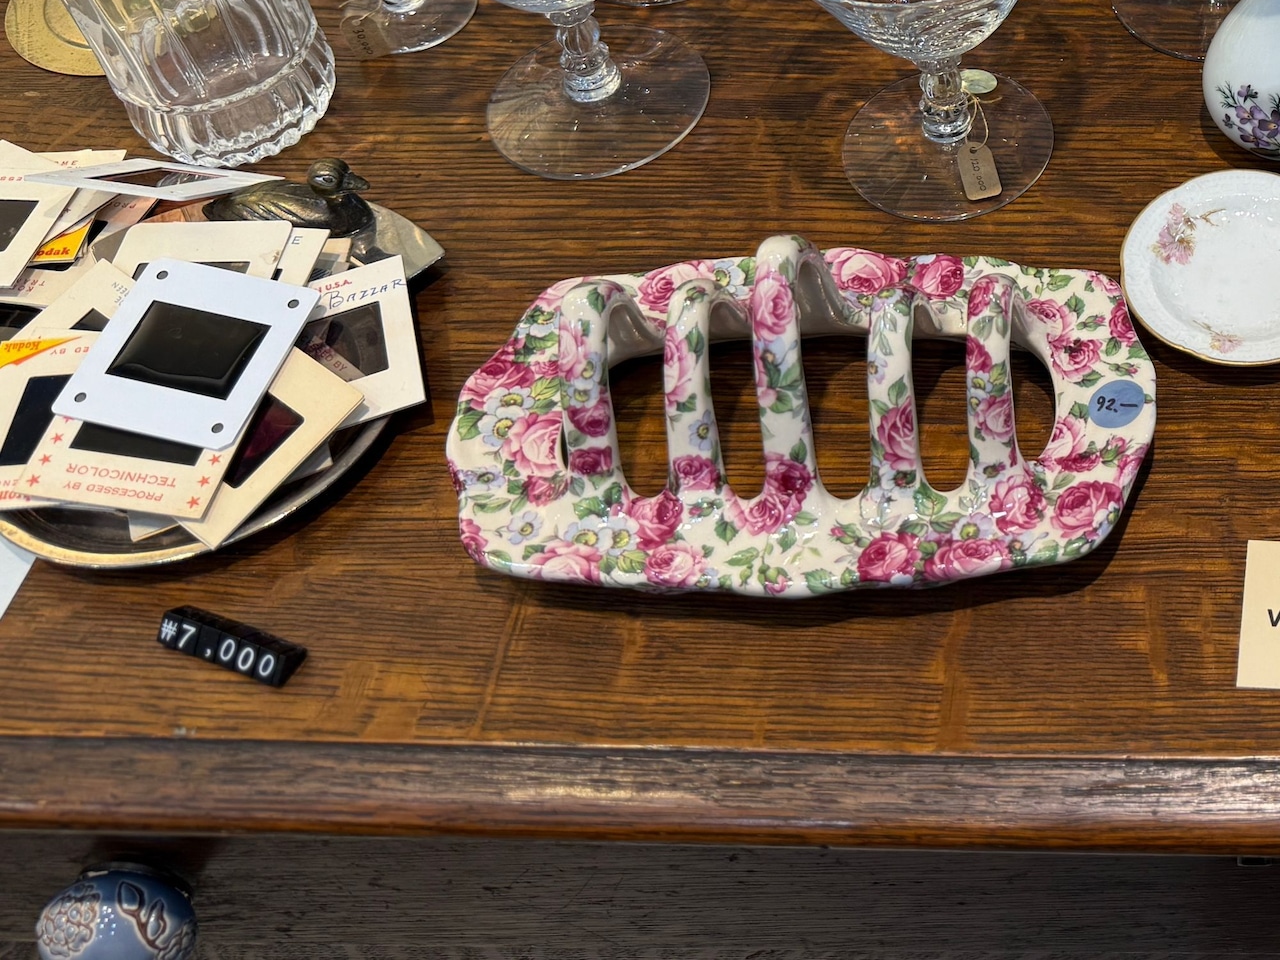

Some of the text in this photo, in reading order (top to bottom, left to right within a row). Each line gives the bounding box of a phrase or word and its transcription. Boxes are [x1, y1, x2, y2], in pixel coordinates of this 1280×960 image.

[36, 247, 70, 257] odak
[325, 279, 352, 291] U.S.A.
[3, 341, 42, 353] Kodak
[332, 361, 348, 372] BY
[66, 463, 177, 488] TECHNICOLOR
[63, 480, 163, 502] PROCESSED BY
[161, 618, 275, 676] ₩7,000
